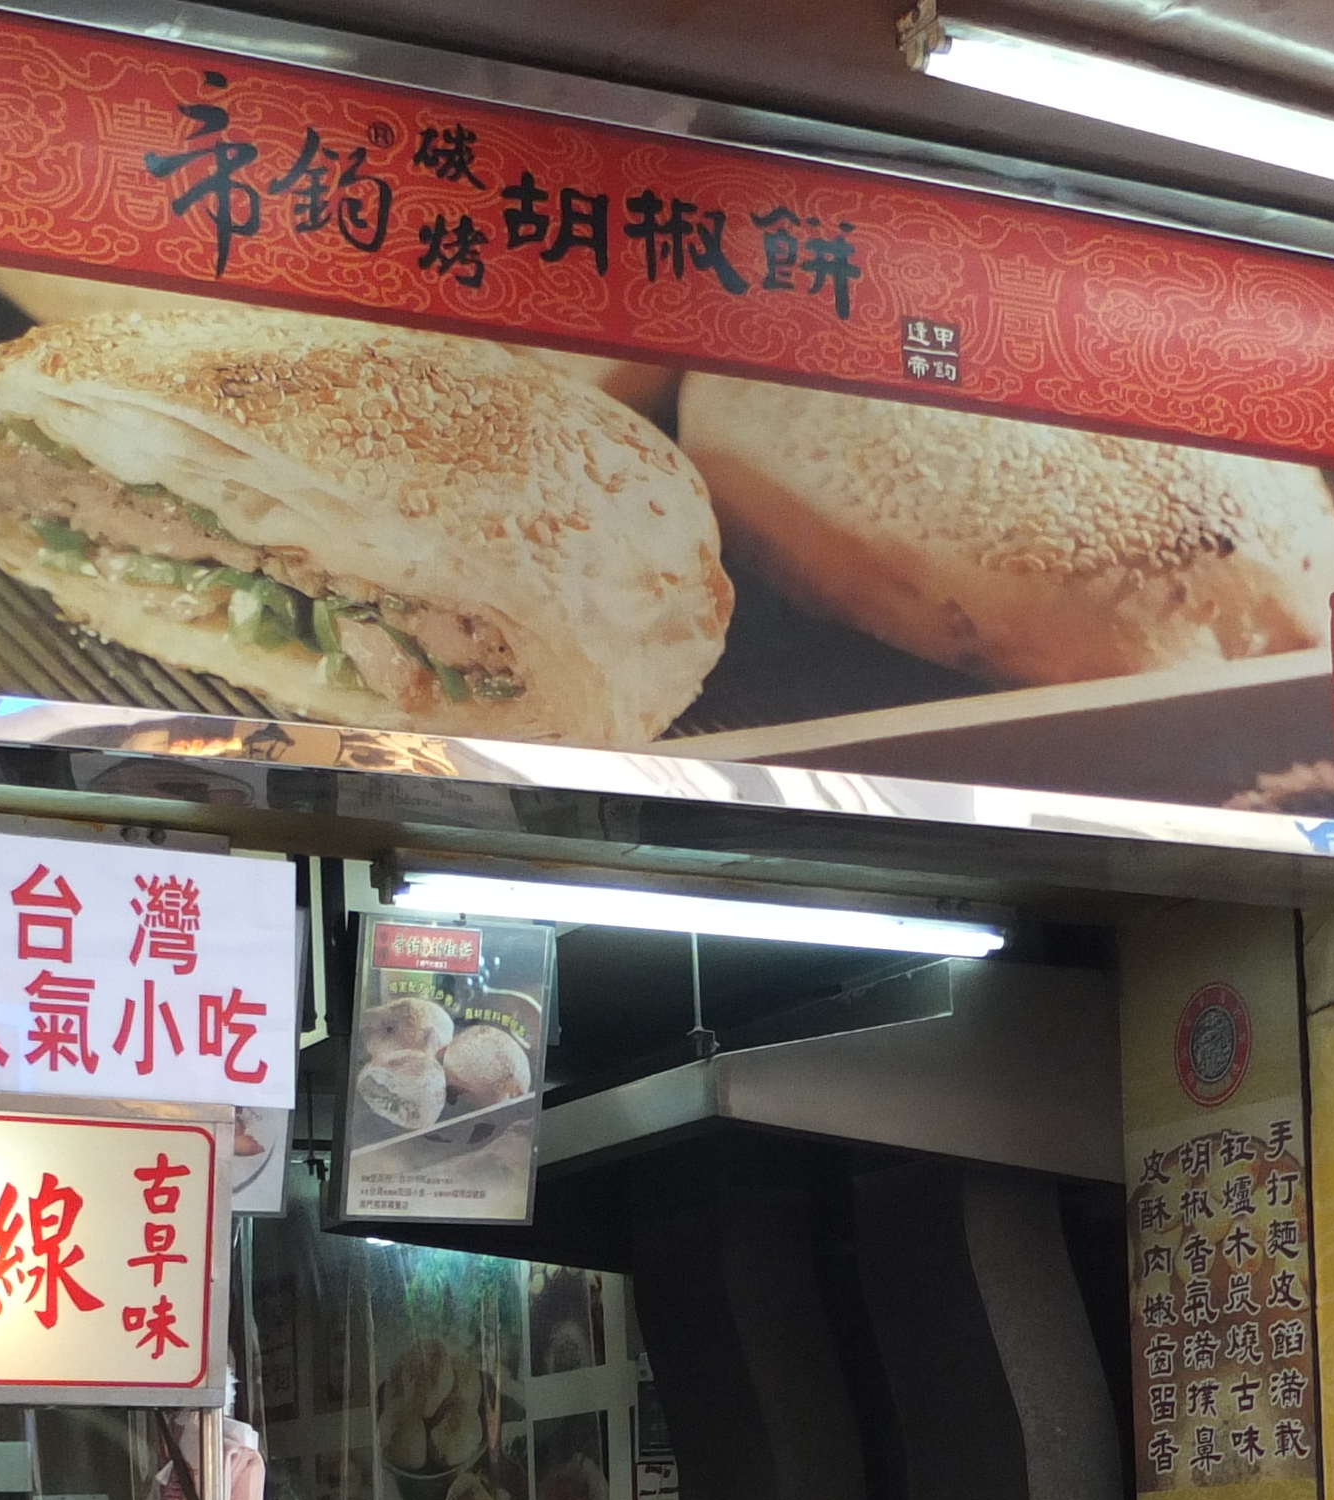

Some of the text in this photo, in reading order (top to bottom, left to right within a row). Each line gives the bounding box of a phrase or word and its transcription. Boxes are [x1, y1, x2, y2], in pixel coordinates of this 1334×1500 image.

[500, 171, 863, 319] 胡椒餅
[11, 864, 202, 977] 台灣
[120, 1152, 192, 1360] 古早味
